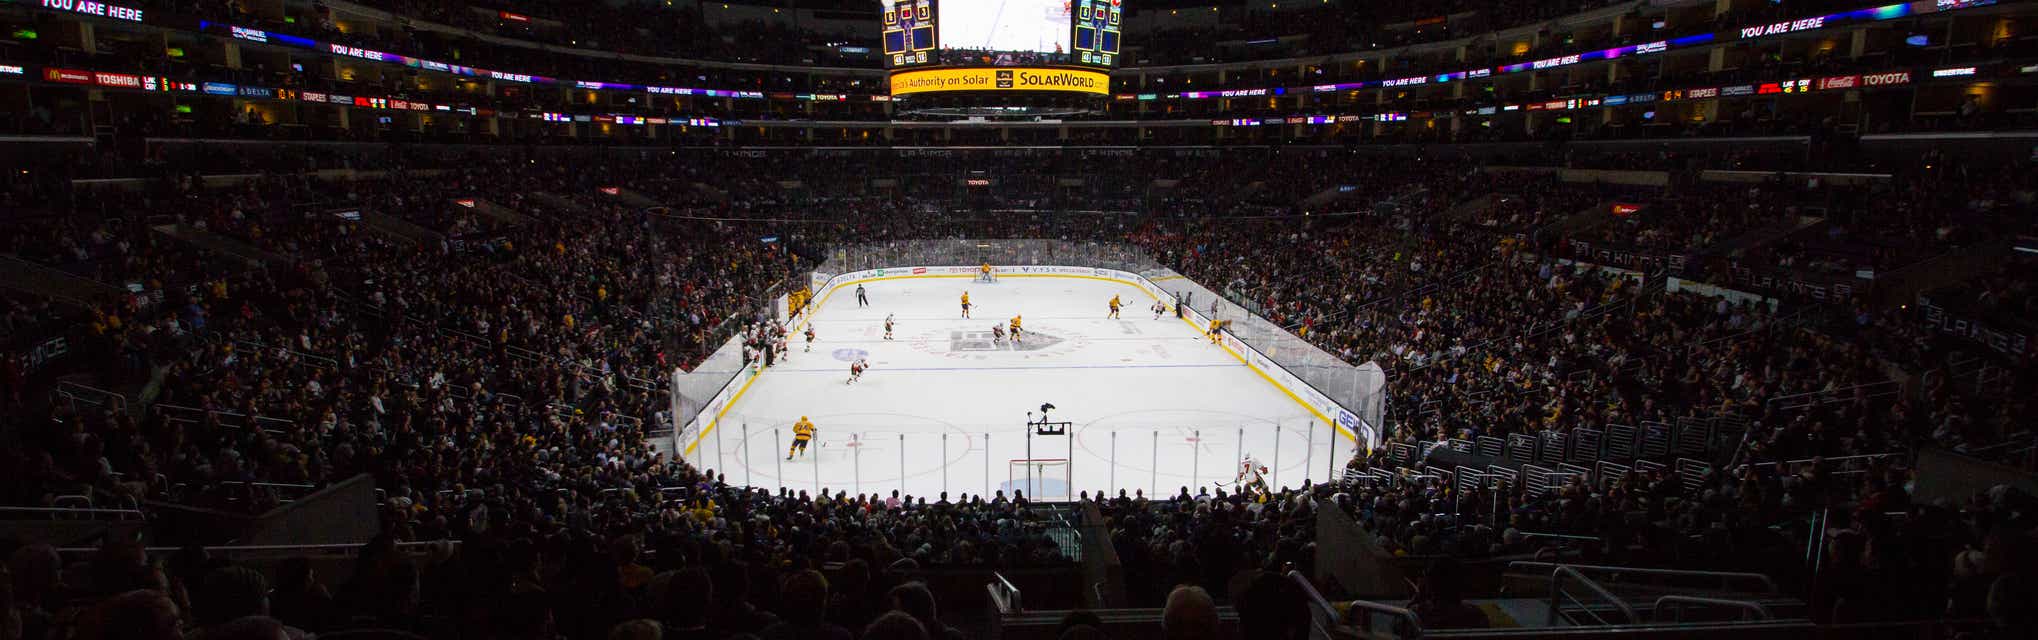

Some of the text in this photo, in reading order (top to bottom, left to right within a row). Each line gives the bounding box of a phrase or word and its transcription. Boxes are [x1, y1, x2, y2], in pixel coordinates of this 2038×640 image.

[43, 0, 143, 21] YOU ARE HERE
[1740, 17, 1824, 39] YOU ARE HERE
[331, 44, 383, 61] YOU ARE HERE
[1533, 54, 1580, 69] YOU ARE HERE
[96, 74, 140, 87] TOSHIBA
[491, 71, 532, 83] YOU ARE HERE
[909, 76, 946, 88] Authority
[947, 77, 960, 85] on
[963, 75, 989, 85] Solar
[1382, 76, 1427, 88] YOU ARE HERE
[1863, 72, 1910, 85] TOYOTA
[247, 88, 270, 96] DELTA
[303, 92, 327, 102] STAPLES
[647, 86, 660, 94] YOU
[660, 87, 674, 95] ARE
[1689, 88, 1717, 98] STAPLES
[410, 102, 430, 111] TOYOTA
[1339, 410, 1369, 439] GEIO
